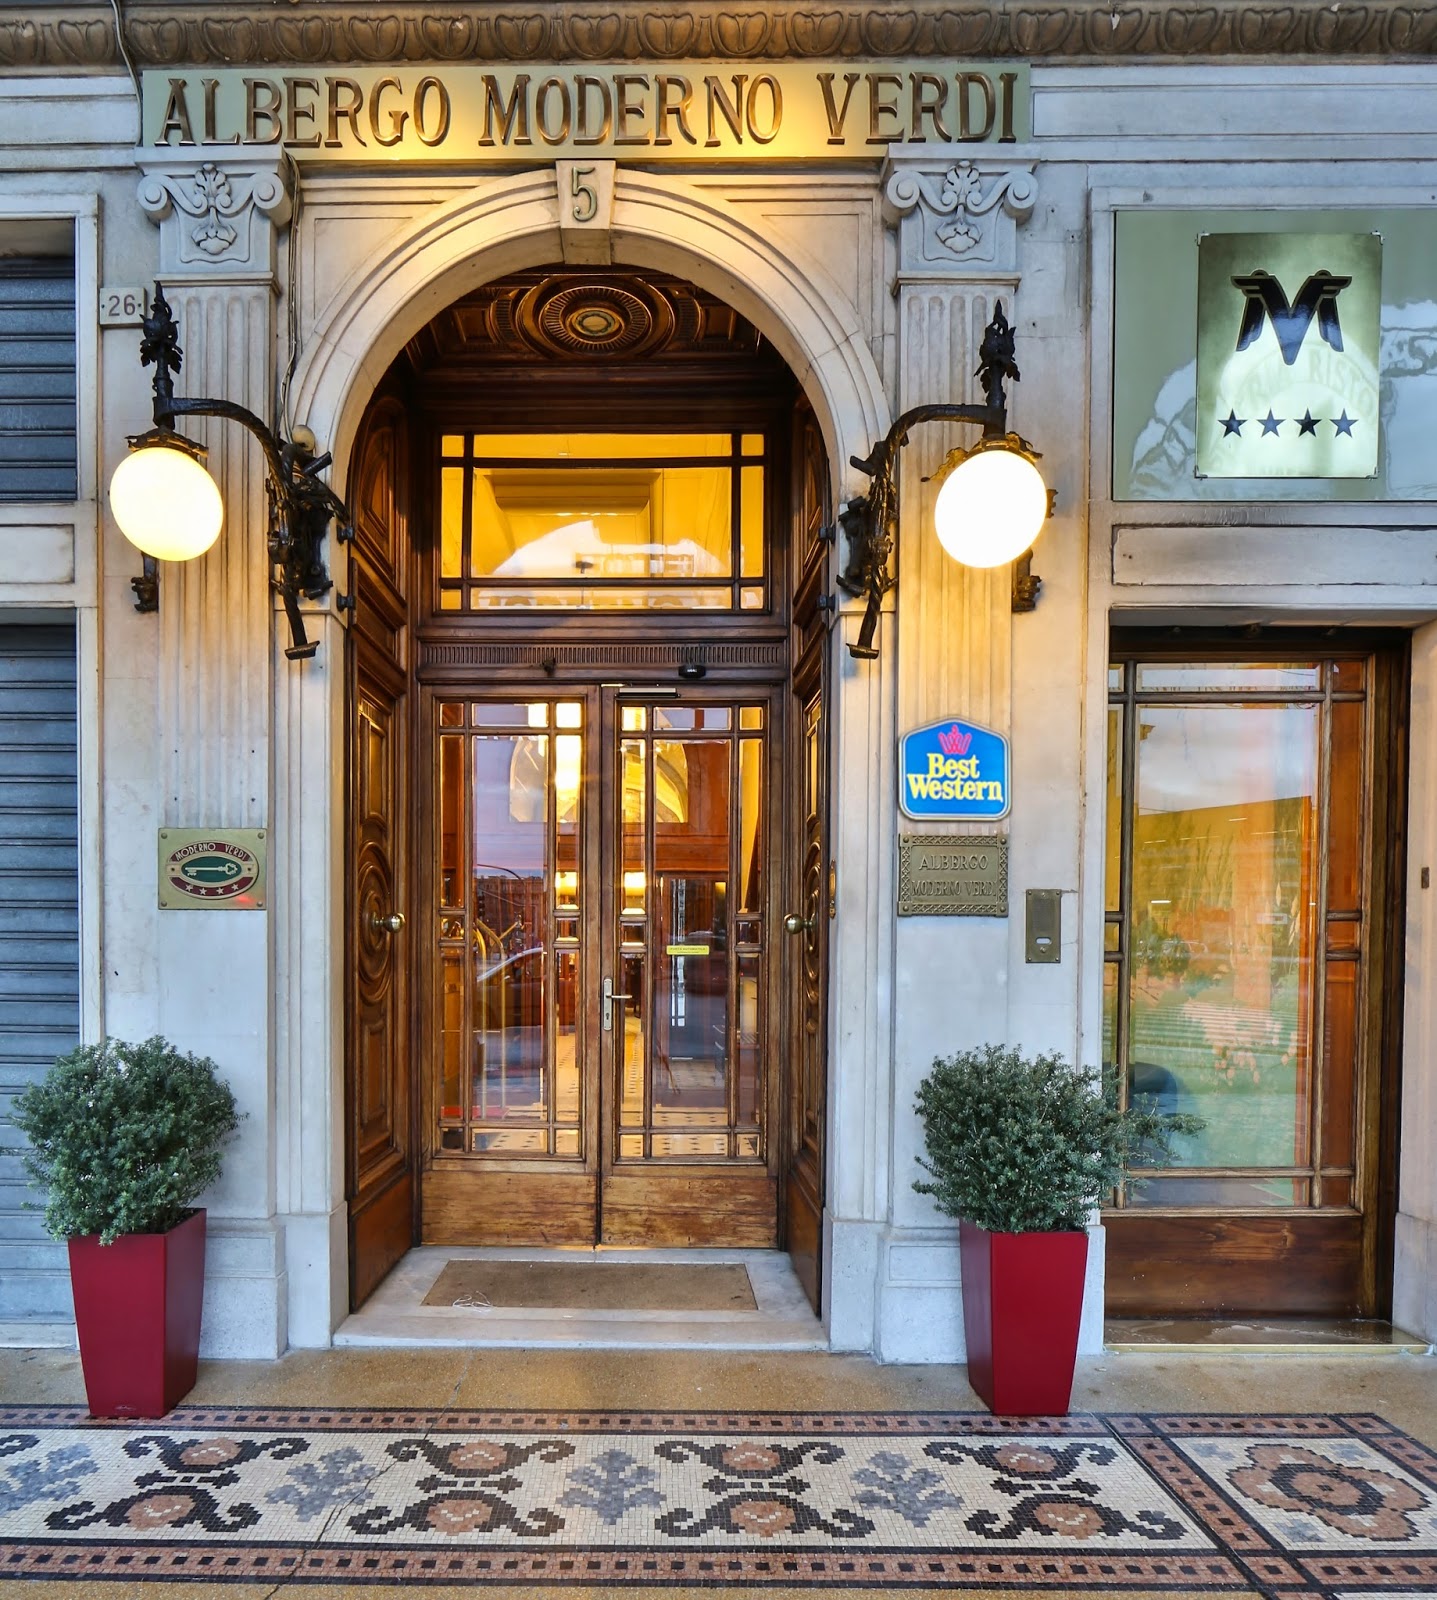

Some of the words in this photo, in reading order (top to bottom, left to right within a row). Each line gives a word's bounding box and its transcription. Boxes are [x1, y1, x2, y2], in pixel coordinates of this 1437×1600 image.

[154, 75, 451, 147] ALBERGO
[478, 73, 782, 147] MODERNO
[816, 72, 1018, 145] VERDI
[571, 167, 597, 222] 5
[109, 294, 136, 316] 26
[927, 754, 980, 779] Best
[907, 774, 1003, 803] Western
[175, 842, 216, 861] MODERNO
[225, 844, 247, 860] VERDI
[918, 854, 989, 870] ALBERGO
[911, 880, 961, 896] MODERNO
[964, 880, 997, 896] VERDI
